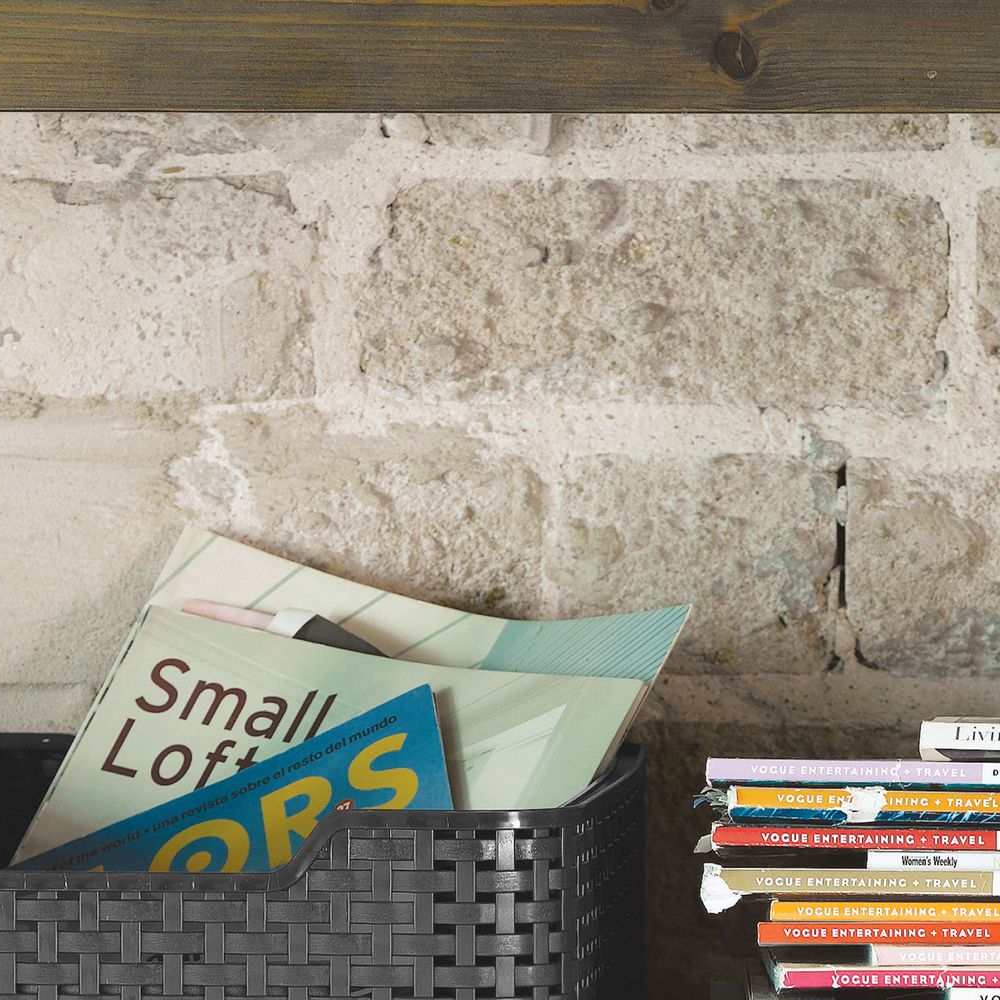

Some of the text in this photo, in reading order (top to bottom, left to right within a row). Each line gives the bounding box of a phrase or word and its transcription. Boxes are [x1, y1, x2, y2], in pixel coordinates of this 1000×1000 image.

[135, 658, 338, 743] Small
[955, 726, 1000, 741] Livi
[750, 765, 795, 775] VOGUE
[801, 765, 898, 777] ENTERTAINING
[916, 768, 966, 777] TRAVEL
[101, 828, 140, 853] world
[151, 814, 179, 831] una
[181, 795, 229, 820] revista
[230, 776, 270, 802] sobre
[288, 751, 322, 773] resto
[324, 738, 347, 756] del
[350, 714, 398, 744] mundo
[88, 732, 419, 873] ORS
[777, 794, 822, 803] VOGUE
[947, 798, 998, 807] TRAVEL
[761, 832, 808, 843] VOGUE
[814, 834, 915, 845] ENTERTAINING
[933, 836, 985, 845] TRAVEL
[901, 855, 958, 868] Women's Weekly
[756, 877, 801, 887] VOGUE
[807, 878, 907, 888] ENTERTAINING
[925, 879, 976, 888] TRAVEL
[797, 907, 839, 916] VOGUE
[844, 907, 936, 916] ENTERTAINING
[952, 907, 999, 916] TRAVEL
[784, 928, 827, 937] VOGUE
[832, 928, 926, 938] ENTERTAINING
[942, 929, 990, 938] TRAVEL
[899, 952, 943, 961] VOGUE
[831, 975, 878, 985] VOGUE
